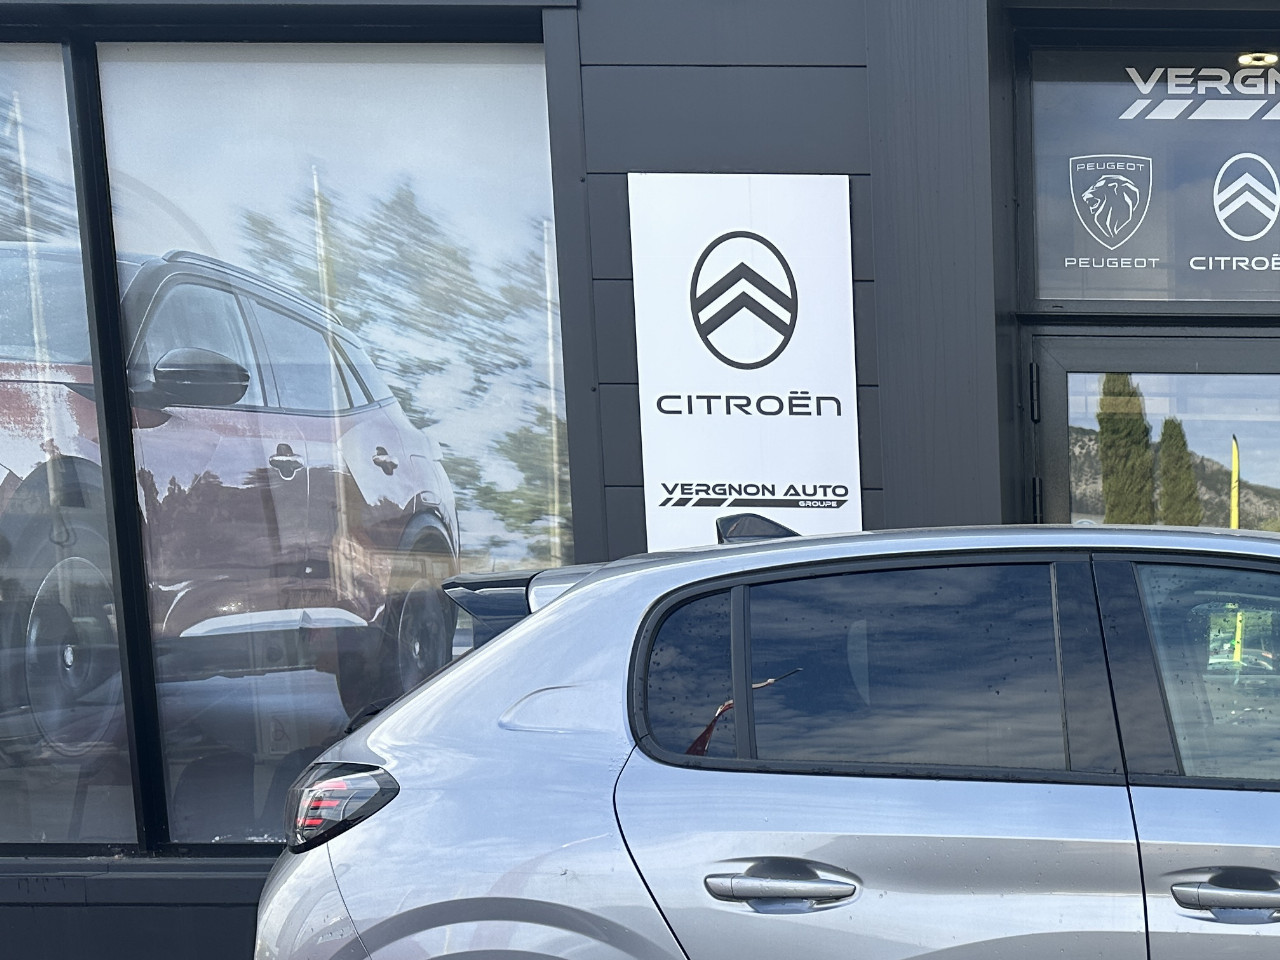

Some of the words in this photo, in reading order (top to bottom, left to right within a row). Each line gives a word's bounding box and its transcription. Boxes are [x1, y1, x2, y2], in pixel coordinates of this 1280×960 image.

[1076, 163, 1145, 172] PEUGEOT
[1064, 258, 1160, 268] PEUGEOT
[656, 390, 842, 417] CITROËN
[661, 483, 775, 497] VERGNON
[783, 484, 849, 498] AUTO
[798, 500, 838, 508] GROUPE
